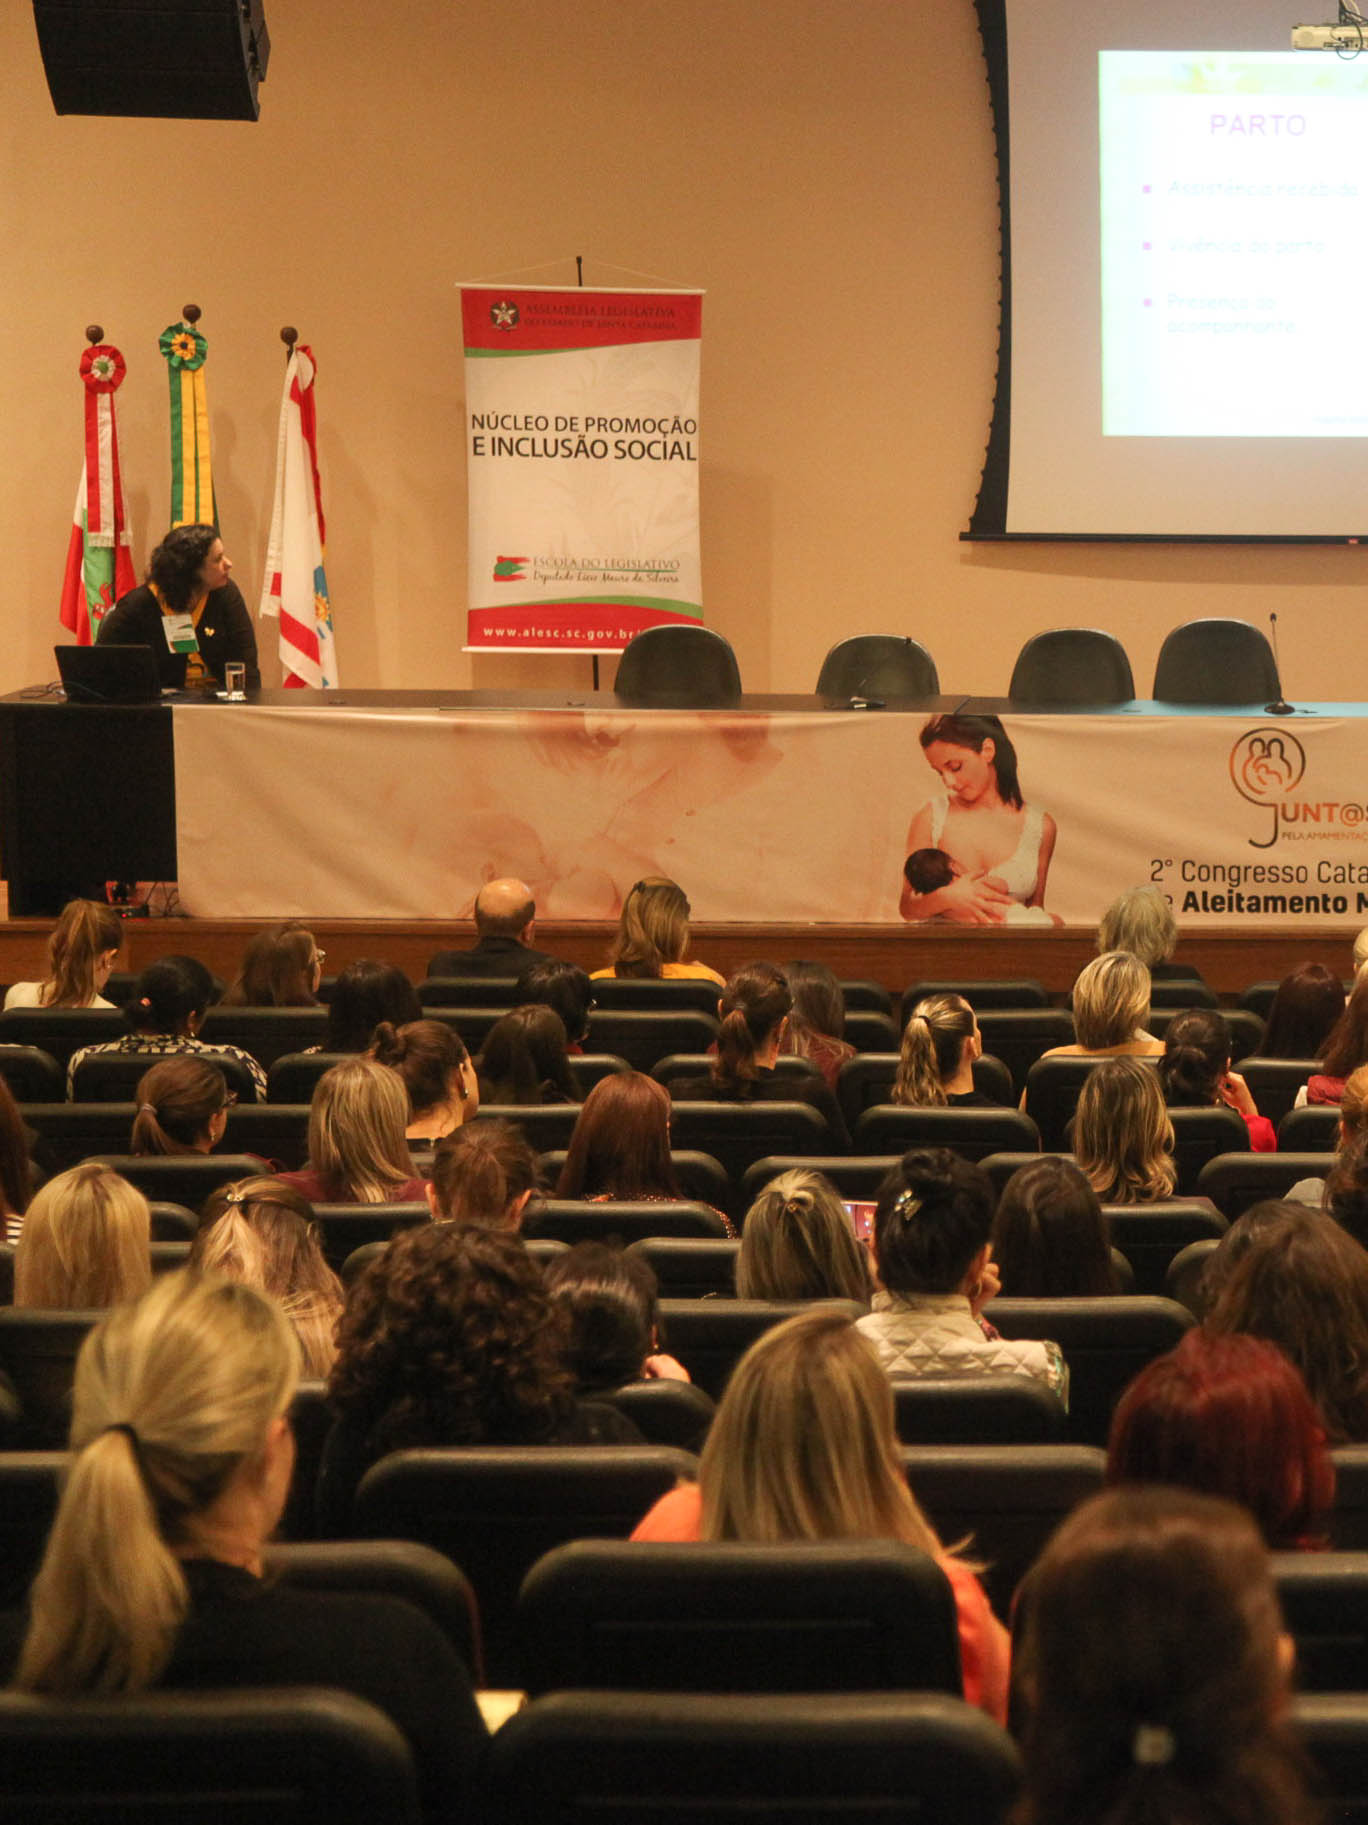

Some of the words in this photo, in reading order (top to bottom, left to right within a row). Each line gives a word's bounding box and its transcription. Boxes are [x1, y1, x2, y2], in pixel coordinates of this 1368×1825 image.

[1209, 113, 1307, 137] PARTO
[471, 411, 549, 432] NÚCLEO
[554, 416, 580, 432] DE
[585, 416, 697, 438] PROMOÇÃO
[472, 436, 486, 457] E
[491, 434, 609, 460] INCLUSÃO
[614, 439, 697, 462] SOCIAL
[533, 556, 578, 568] ESCOLA
[581, 558, 600, 569] DO
[604, 558, 681, 570] LEGISLATIVO
[483, 626, 641, 641] www.alesc.sc.gov.br
[1150, 859, 1173, 882] 2°
[1181, 859, 1308, 888] Congresso
[1181, 889, 1348, 914] Aleitamento
